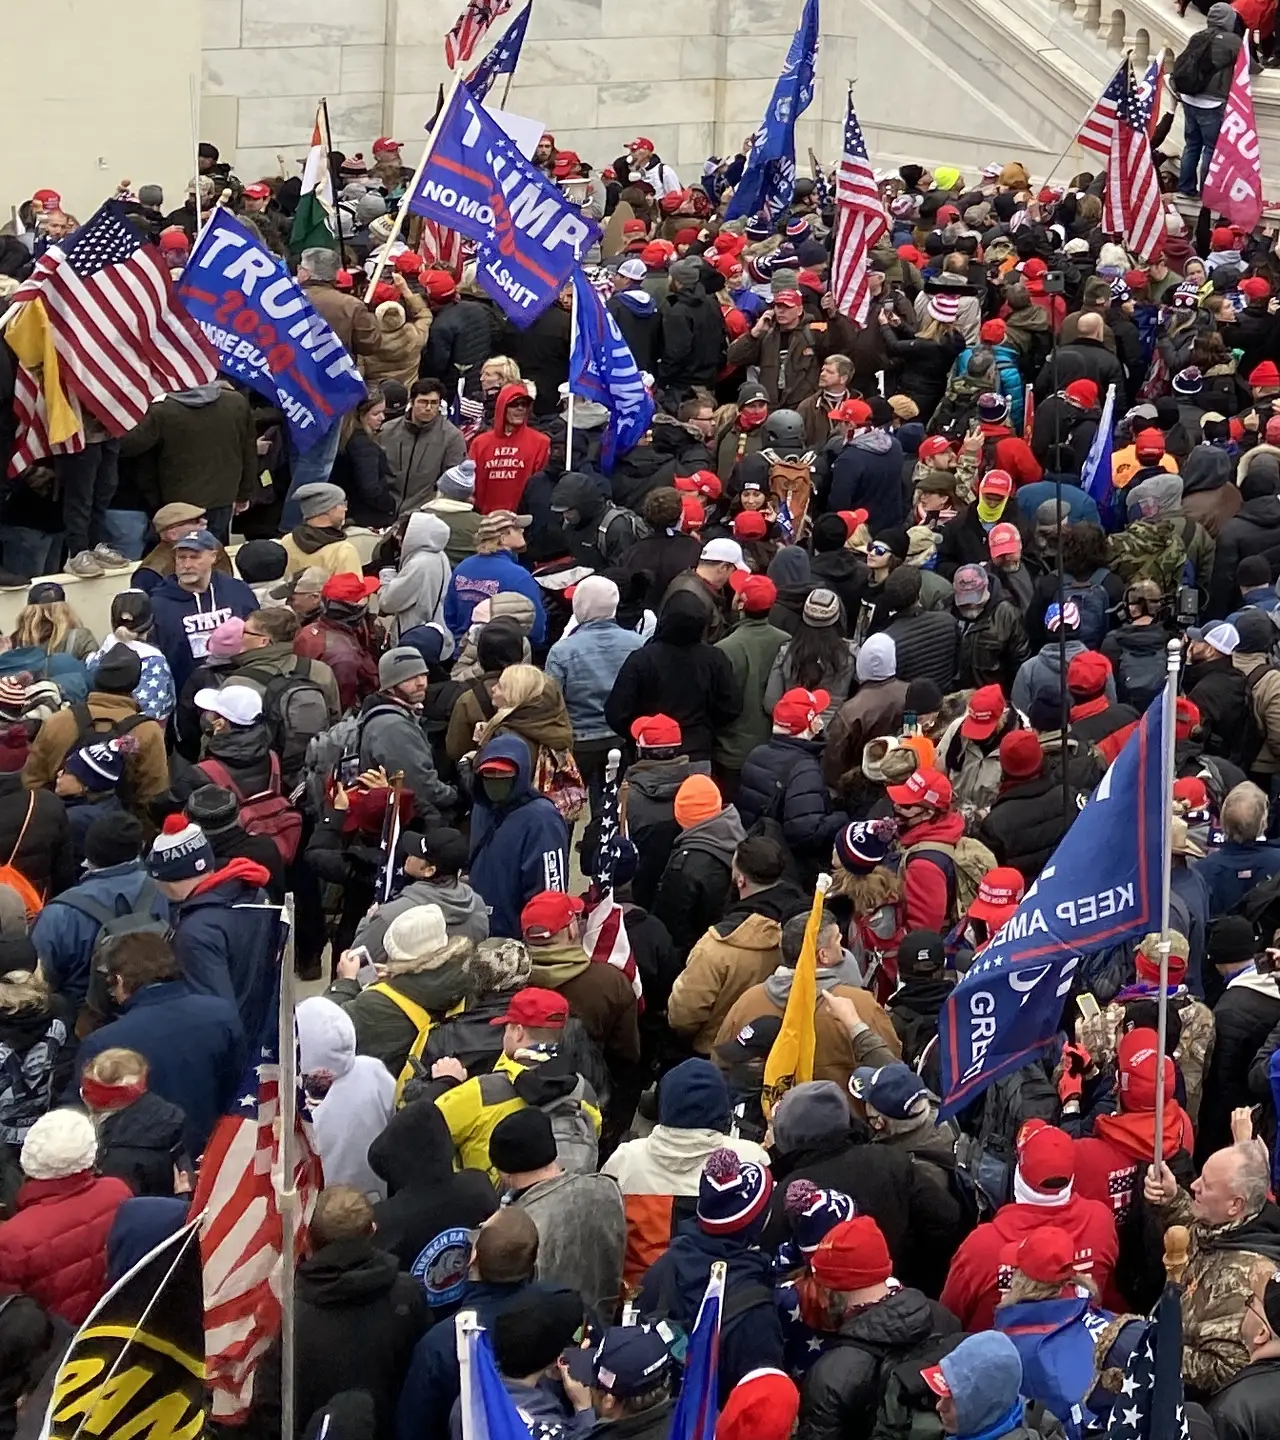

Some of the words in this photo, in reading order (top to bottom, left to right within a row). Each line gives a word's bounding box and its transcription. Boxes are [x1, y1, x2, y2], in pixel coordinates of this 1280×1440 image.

[421, 179, 457, 208] NO
[494, 446, 519, 457] KEEP
[485, 459, 525, 471] AMERICA
[488, 470, 517, 480] GREAT
[182, 607, 232, 633] STATE
